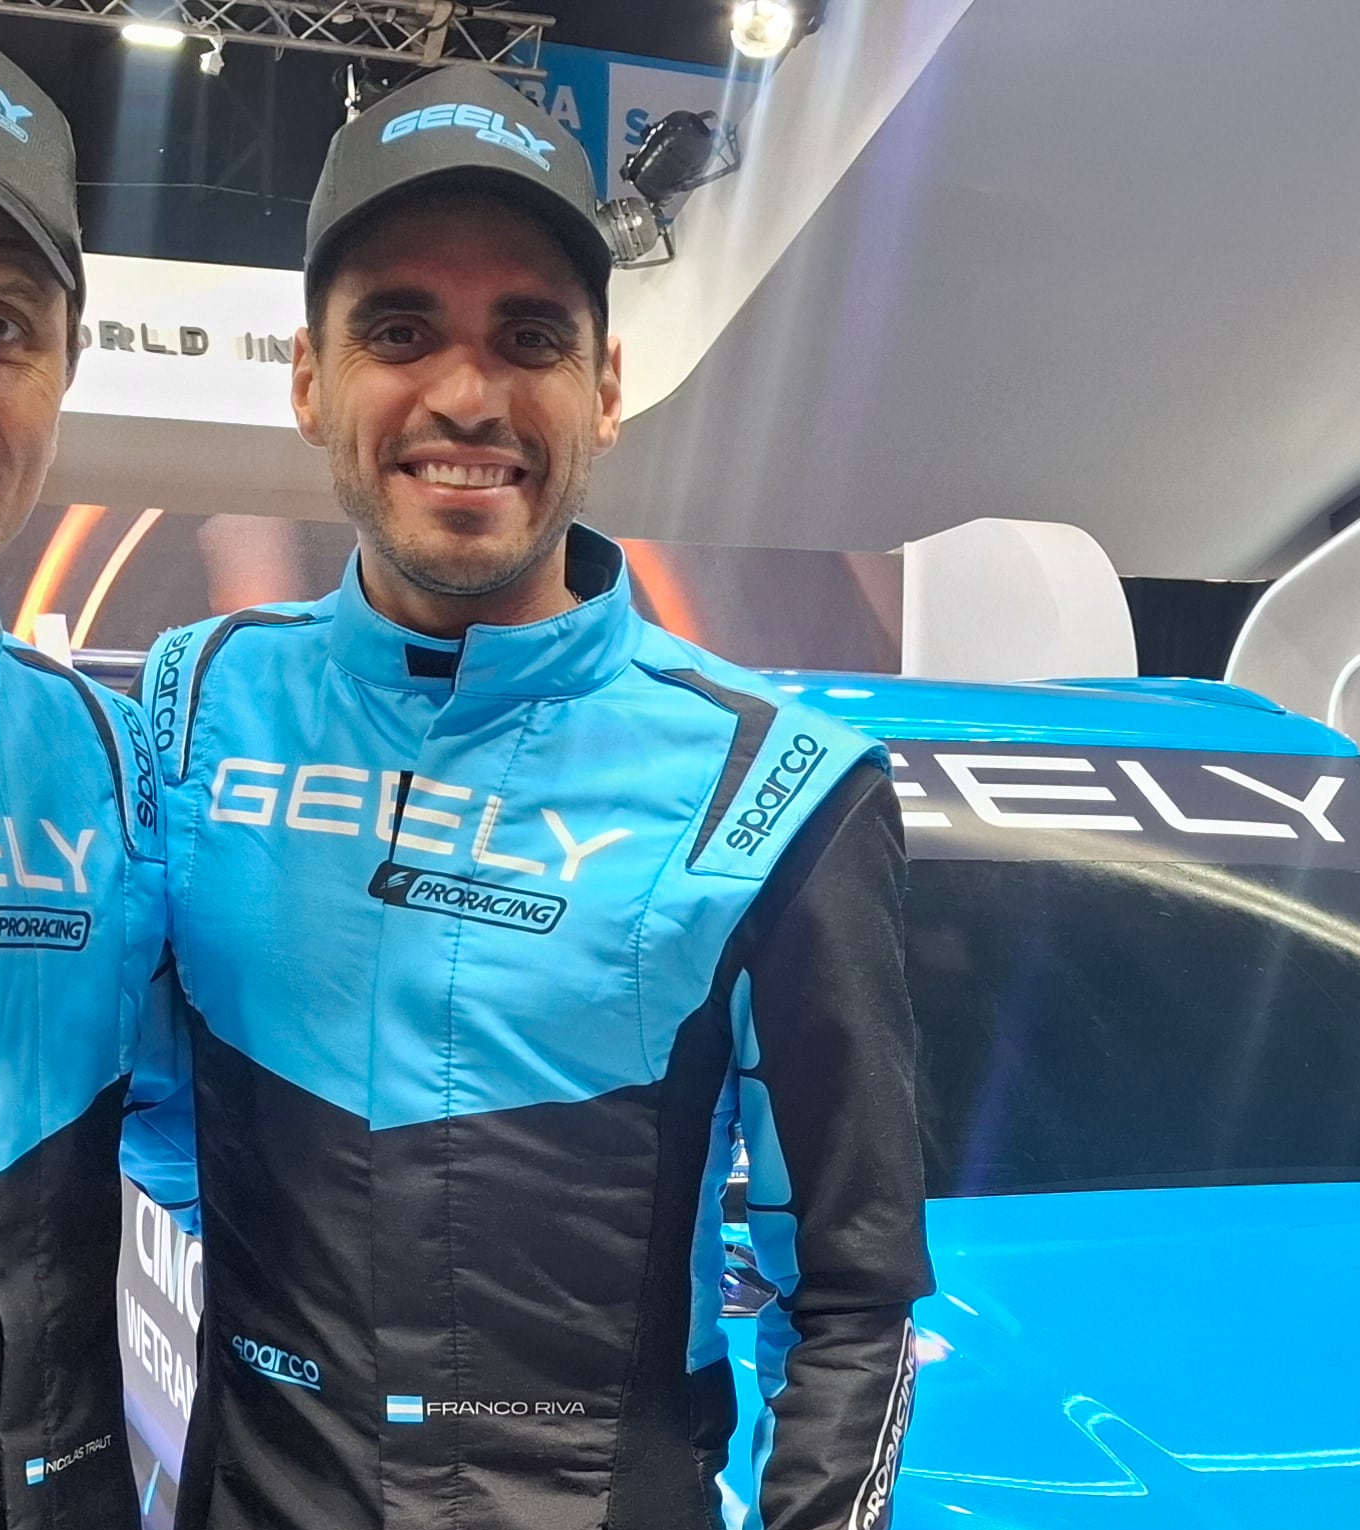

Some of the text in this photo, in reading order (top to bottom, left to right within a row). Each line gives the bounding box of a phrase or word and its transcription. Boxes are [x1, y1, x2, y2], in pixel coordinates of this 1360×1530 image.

[382, 103, 556, 153] GEELY
[155, 631, 193, 752] sparco
[113, 698, 158, 830] sparco
[210, 757, 635, 882] GEELY
[726, 734, 818, 850] sparco
[411, 878, 556, 924] PRORACING
[125, 1288, 197, 1420] WETRAN
[232, 1335, 320, 1384] sparco
[426, 1401, 585, 1416] FRANCO RIVA
